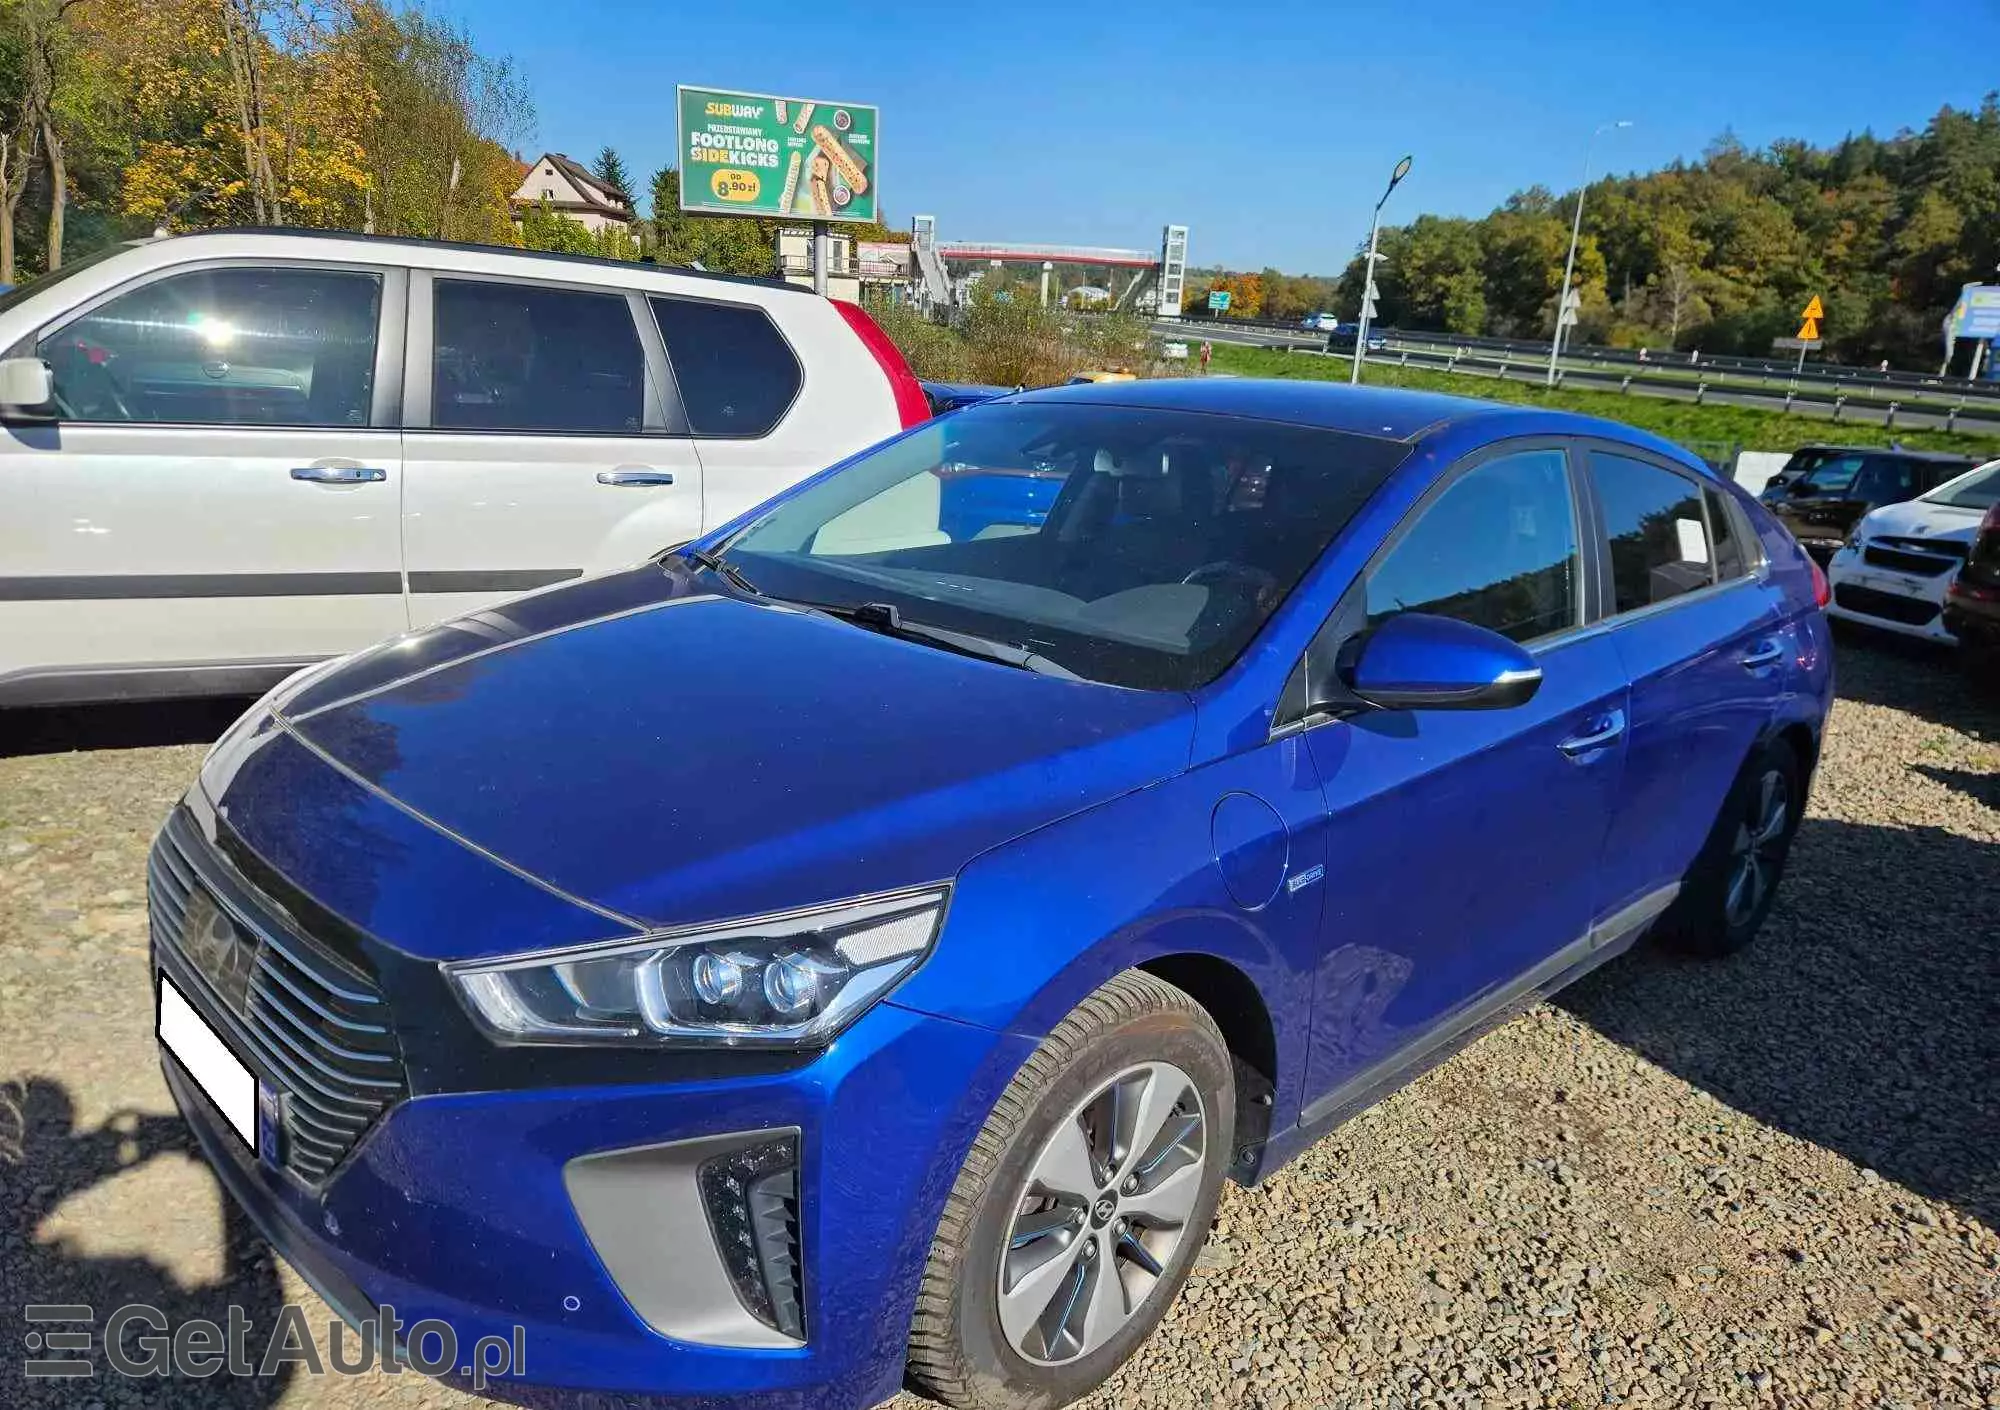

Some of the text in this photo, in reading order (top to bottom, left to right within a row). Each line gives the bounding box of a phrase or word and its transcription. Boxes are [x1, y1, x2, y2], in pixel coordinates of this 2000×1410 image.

[705, 102, 764, 119] SUBWAY
[691, 132, 779, 153] FOOTLONG
[691, 147, 779, 168] SIDEKICKS
